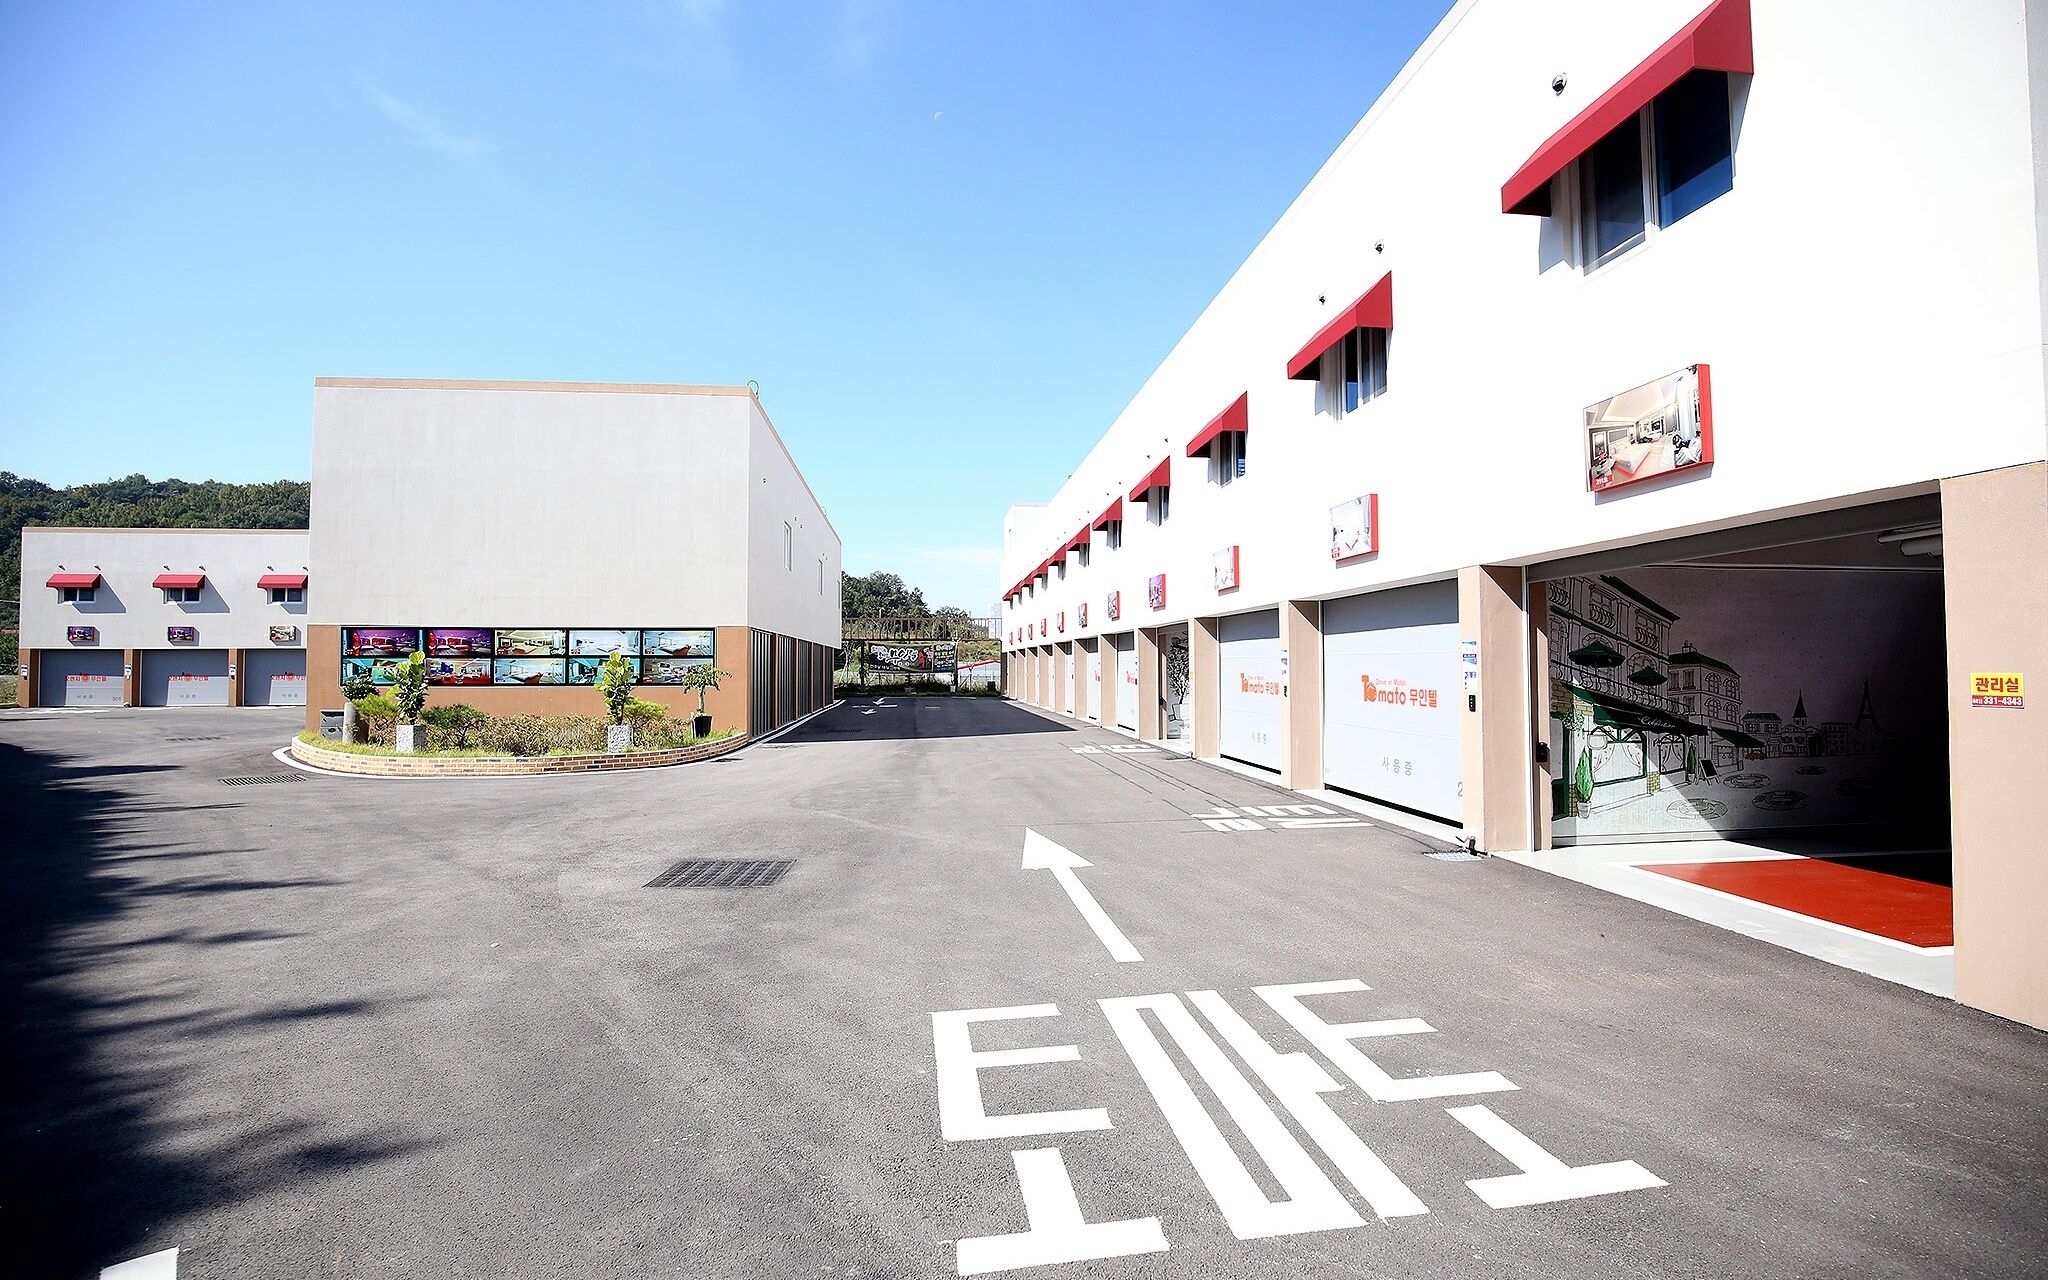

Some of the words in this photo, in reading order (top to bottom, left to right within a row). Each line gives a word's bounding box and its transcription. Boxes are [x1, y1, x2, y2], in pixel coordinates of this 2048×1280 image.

[1975, 677, 2019, 693] 관리실
[1409, 688, 1438, 708] 무인텔
[1381, 756, 1413, 777] 사용중
[930, 978, 1670, 1277] 토마토
